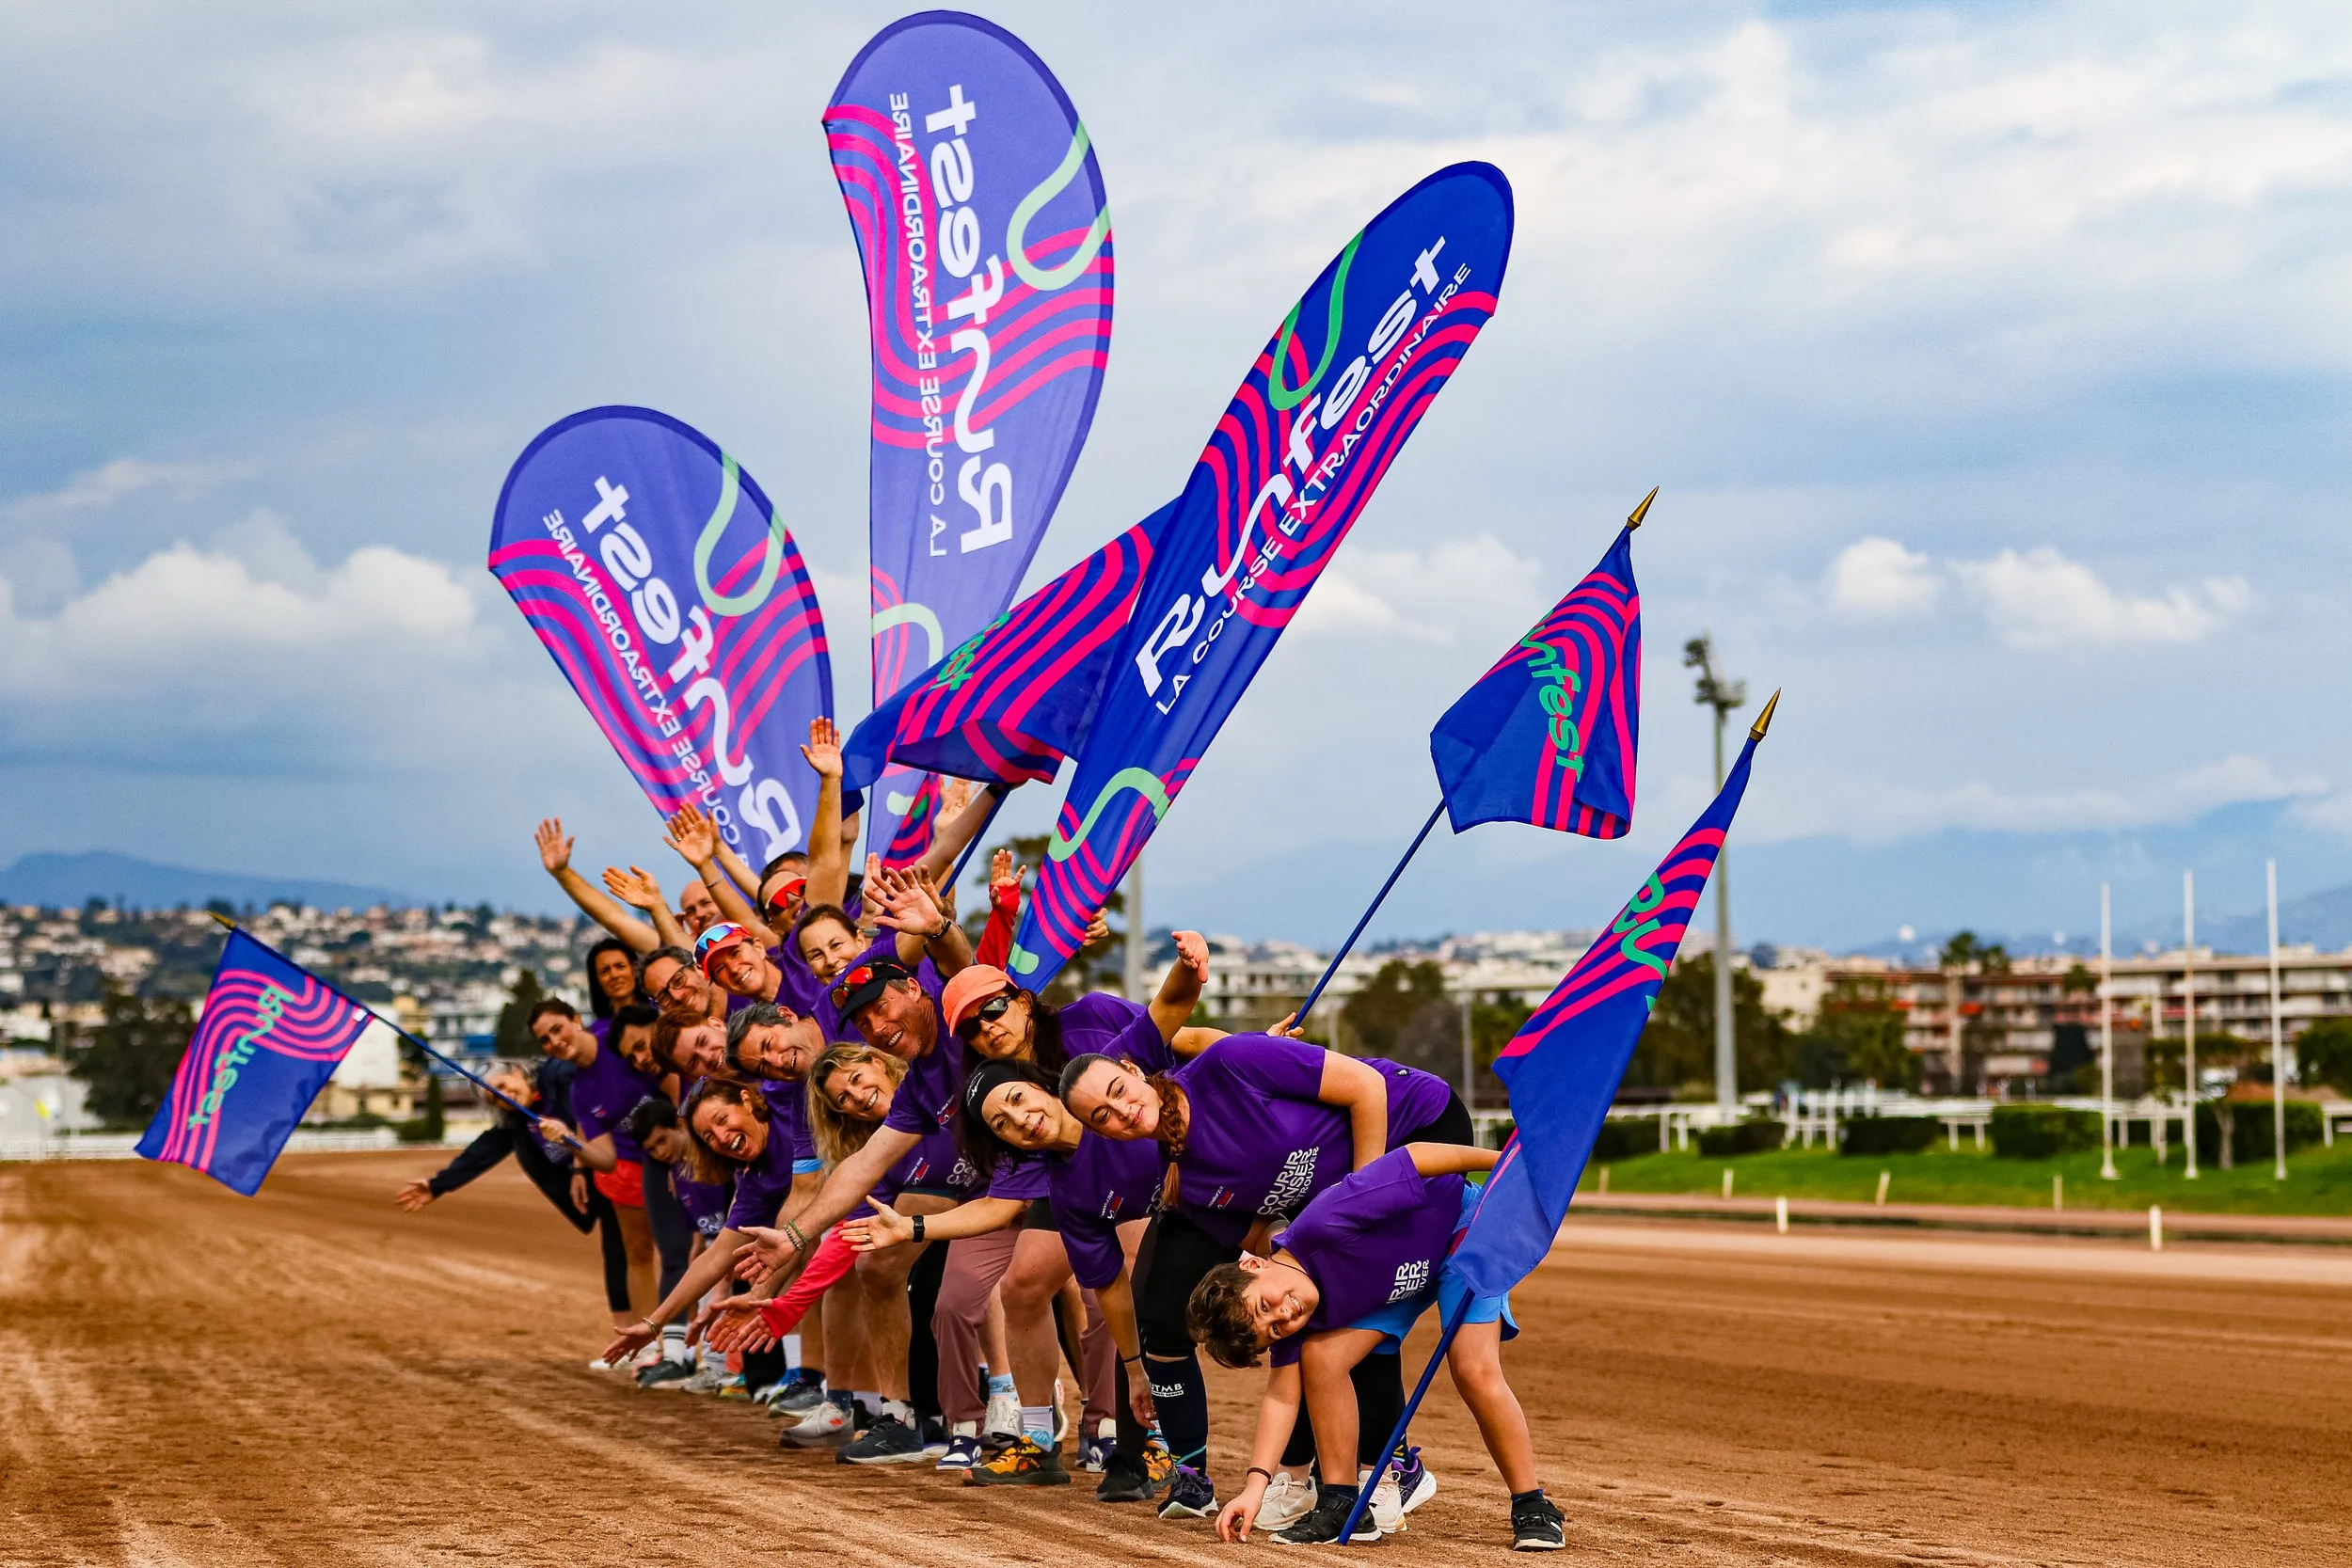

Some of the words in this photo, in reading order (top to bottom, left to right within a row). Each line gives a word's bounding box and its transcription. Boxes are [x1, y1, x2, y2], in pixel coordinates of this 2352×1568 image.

[1155, 673, 1192, 716] LA
[1192, 535, 1284, 665] COURSE
[1279, 262, 1472, 536] EXTRAORDINAIRE
[1256, 1148, 1303, 1215] COURIR
